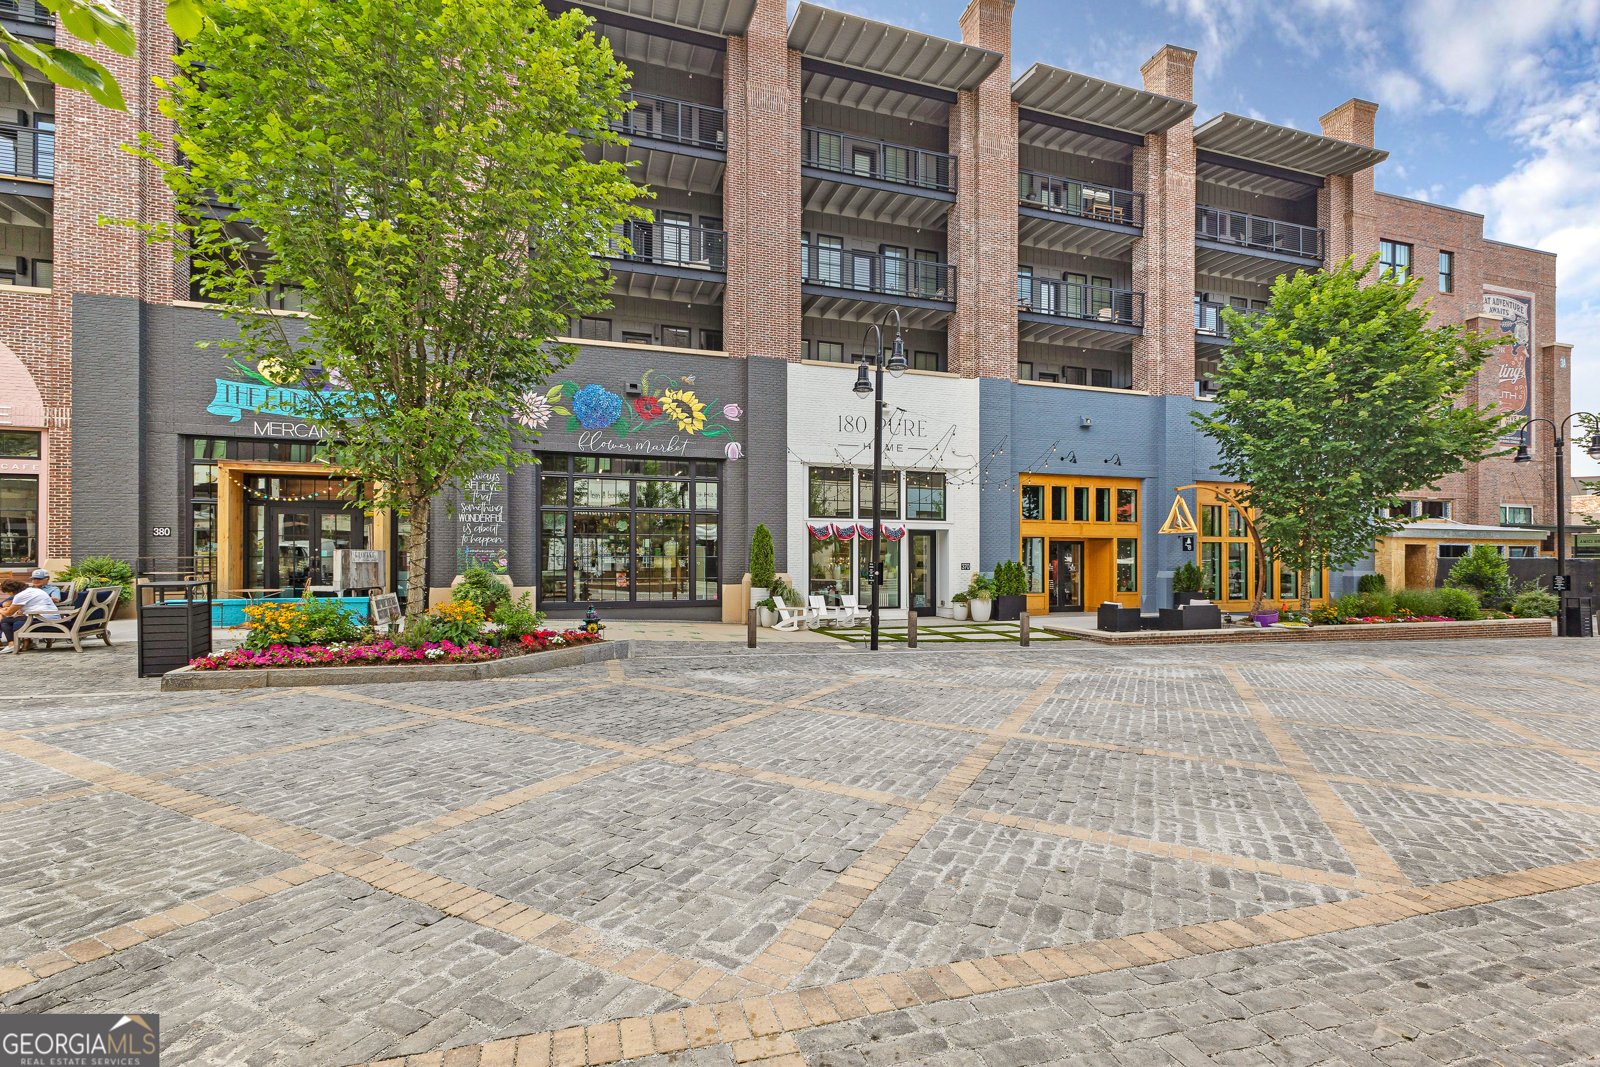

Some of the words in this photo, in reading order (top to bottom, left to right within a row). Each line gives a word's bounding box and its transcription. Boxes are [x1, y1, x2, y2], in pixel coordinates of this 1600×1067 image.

[1488, 307, 1509, 316] AWAITS
[1492, 298, 1525, 314] ADVENTURE
[220, 383, 260, 407] THE
[838, 415, 867, 433] 180
[863, 443, 904, 452] HME
[0, 463, 40, 471] CAFE
[458, 513, 505, 522] WONDERFUL
[153, 527, 170, 536] 380
[474, 522, 501, 536] about
[470, 533, 504, 546] happen
